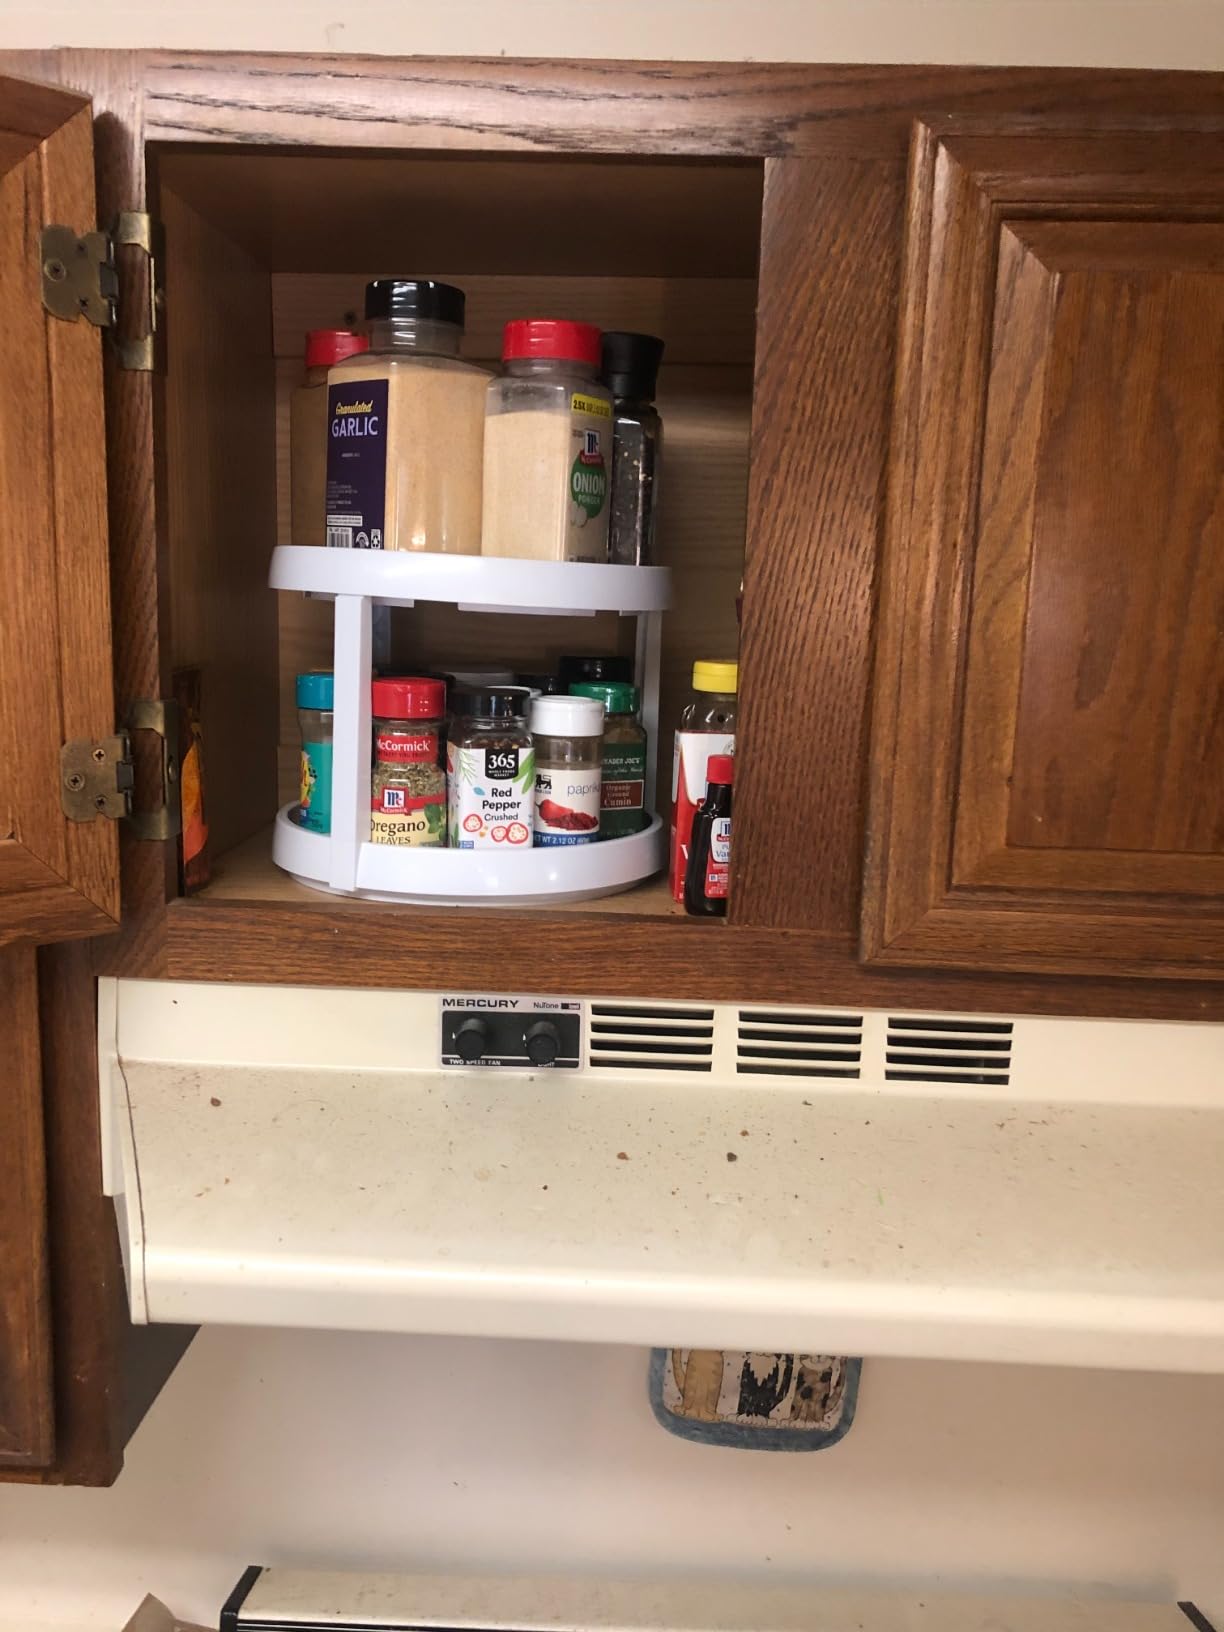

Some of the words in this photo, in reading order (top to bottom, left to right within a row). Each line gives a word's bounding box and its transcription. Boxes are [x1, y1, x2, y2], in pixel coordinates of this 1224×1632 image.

[331, 416, 379, 437] GARLIC
[573, 472, 606, 496] ONION
[488, 753, 515, 769] 365
[491, 787, 512, 797] Red
[482, 800, 521, 811] Pepper
[484, 812, 519, 821] Crushed
[442, 998, 519, 1009] MERCURY
